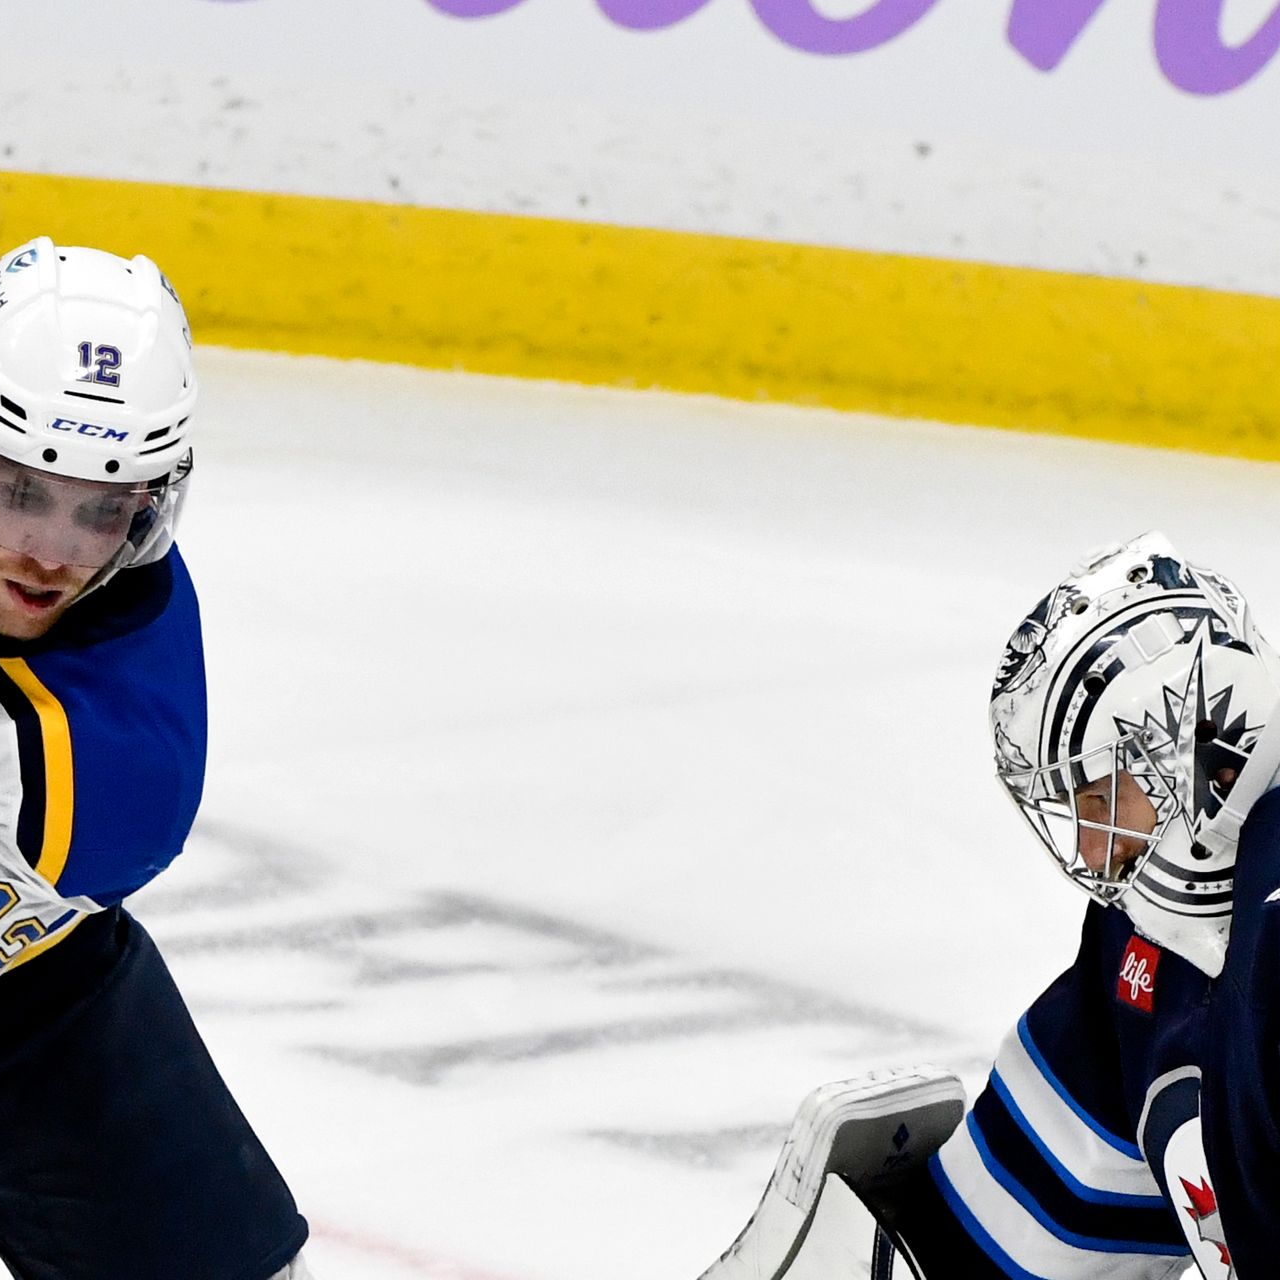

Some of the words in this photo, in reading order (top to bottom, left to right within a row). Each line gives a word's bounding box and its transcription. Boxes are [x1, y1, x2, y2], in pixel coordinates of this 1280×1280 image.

[76, 341, 122, 387] 12
[51, 418, 129, 441] CCM
[1119, 952, 1154, 1001] life
